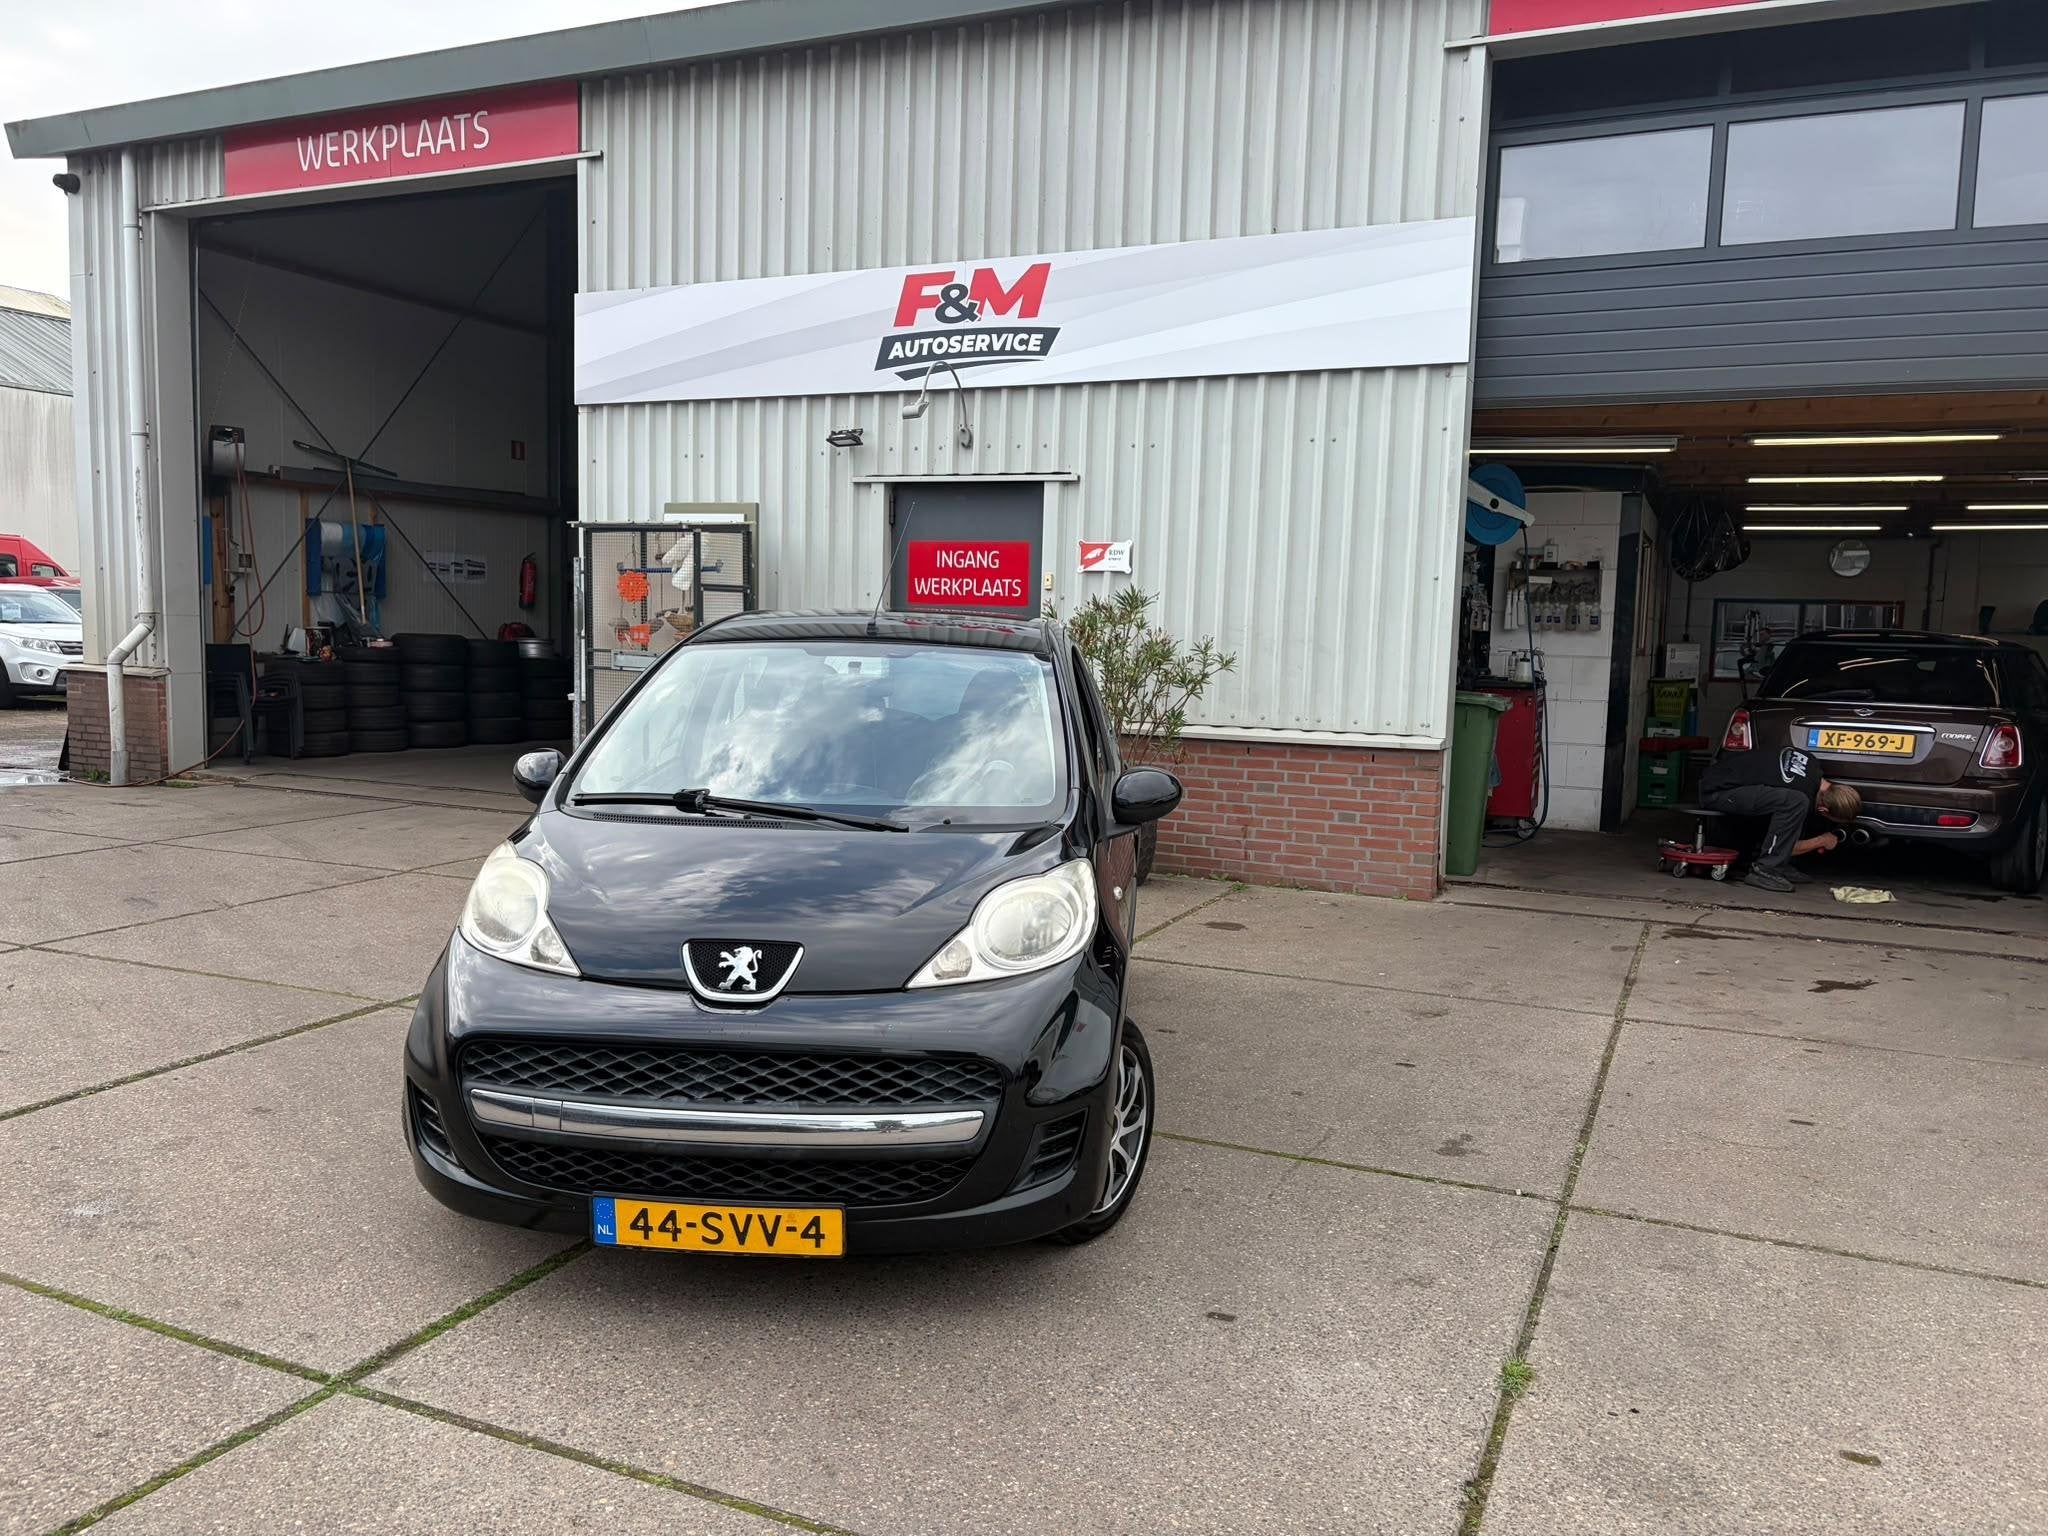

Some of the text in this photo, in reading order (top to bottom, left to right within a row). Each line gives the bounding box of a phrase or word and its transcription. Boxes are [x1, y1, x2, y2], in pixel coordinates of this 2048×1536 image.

[296, 110, 490, 172] WERKPLAATS
[893, 262, 1052, 327] F&M
[887, 332, 1044, 360] AUTOSERVICE
[936, 549, 1000, 569] INGANG
[914, 577, 1022, 597] WERKPLAATS
[1823, 732, 1905, 751] XF-969-J
[597, 1223, 614, 1237] NL
[629, 1207, 826, 1249] 44-SVV-4
